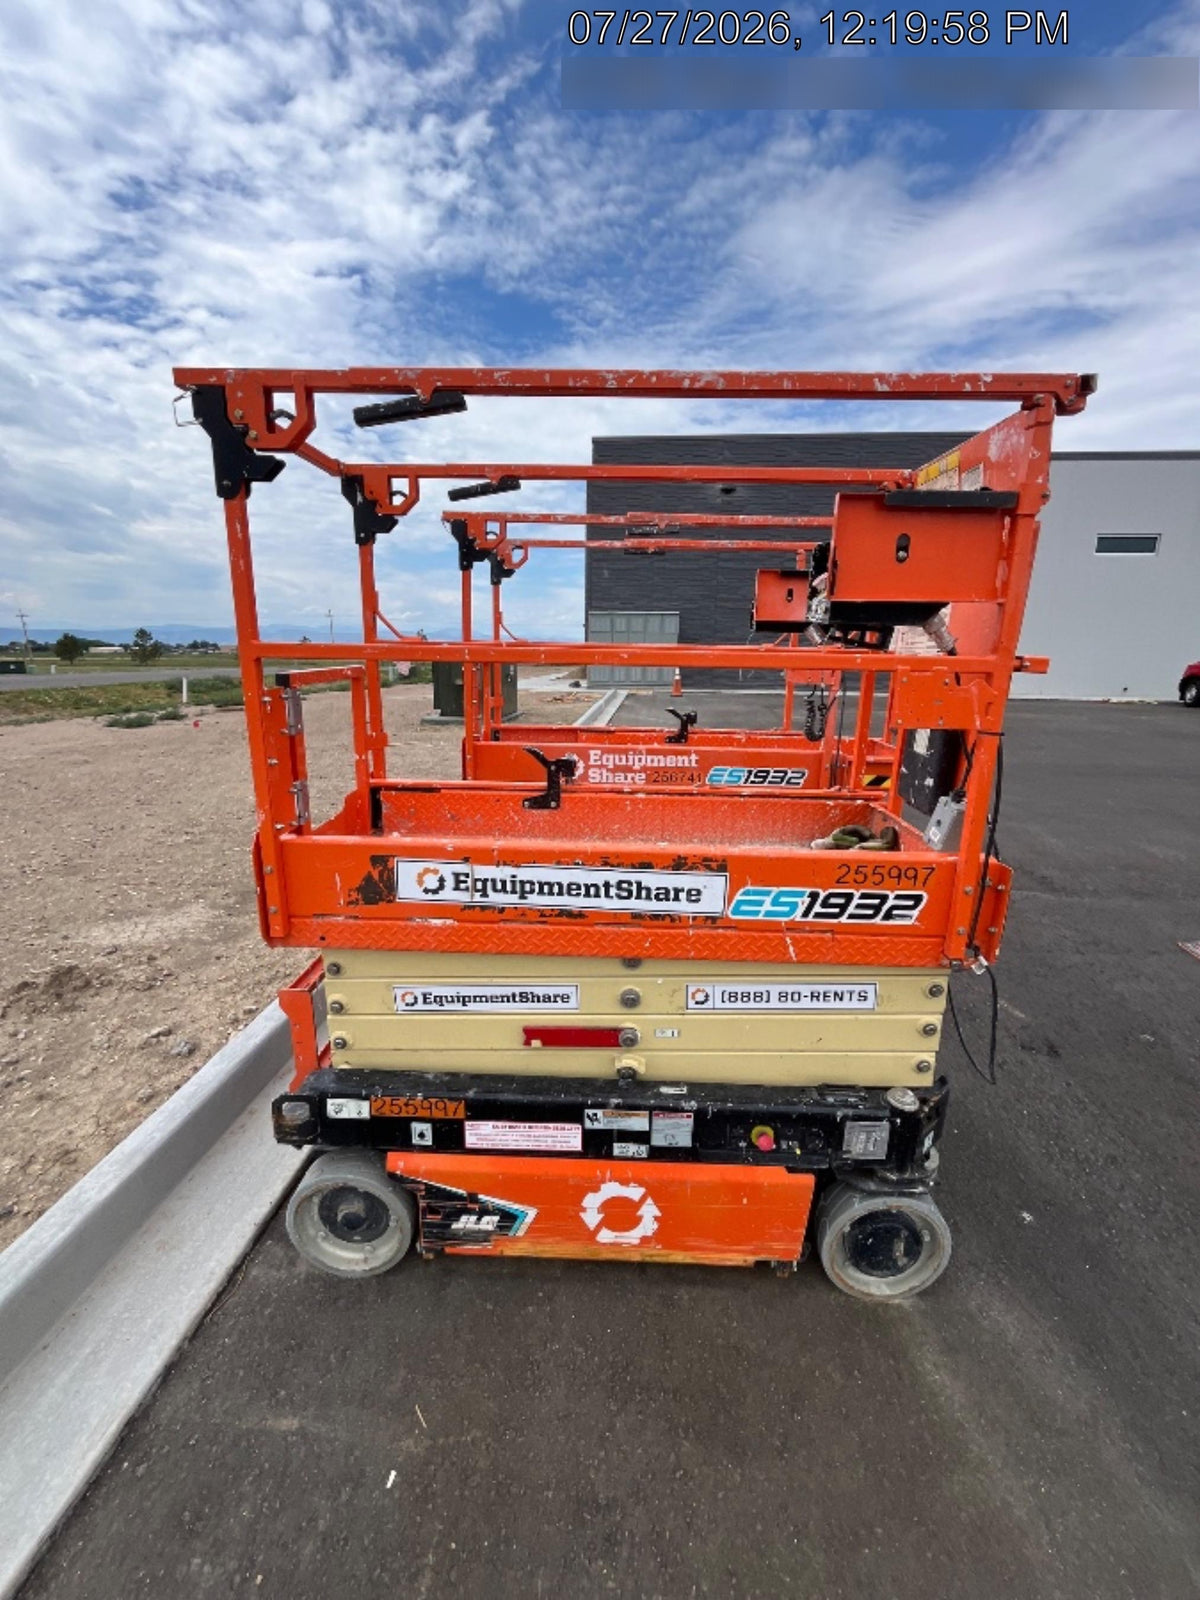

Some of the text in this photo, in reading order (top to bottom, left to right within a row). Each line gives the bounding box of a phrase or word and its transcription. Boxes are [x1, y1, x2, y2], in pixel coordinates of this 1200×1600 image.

[588, 750, 698, 768] Equipment
[588, 768, 646, 784] Share
[707, 767, 807, 787] ES1932
[835, 863, 936, 887] 255997
[451, 871, 703, 903] EquipmentShare
[729, 887, 926, 923] ES1932
[421, 991, 571, 1007] EquipmentShare
[777, 989, 869, 1004] 80-RENTS
[372, 1098, 462, 1118] 255997
